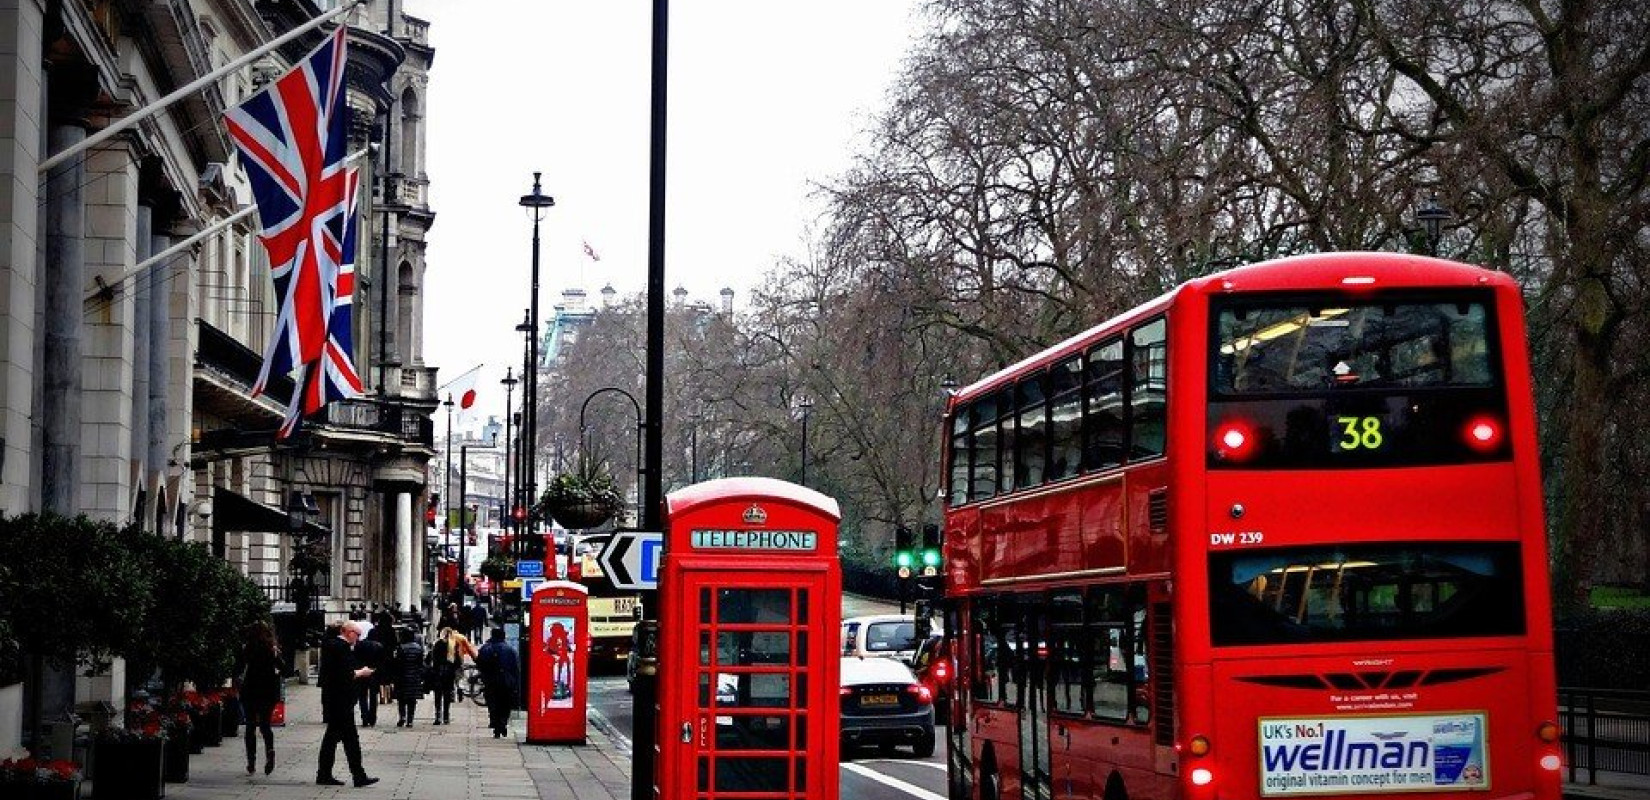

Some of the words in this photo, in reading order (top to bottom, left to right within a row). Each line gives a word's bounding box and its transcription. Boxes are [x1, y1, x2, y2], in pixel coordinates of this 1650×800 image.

[1338, 416, 1382, 450] 38
[694, 530, 814, 549] TELEPHONE
[1211, 533, 1235, 545] DW
[1239, 531, 1264, 544] 239
[1264, 723, 1292, 740] UK's
[1295, 722, 1325, 738] No.1
[1262, 729, 1430, 772] wellman
[1266, 773, 1307, 791] original
[1309, 772, 1349, 788] vitamin
[1351, 771, 1390, 787] concept
[1392, 769, 1407, 785] for
[1409, 772, 1433, 784] men
